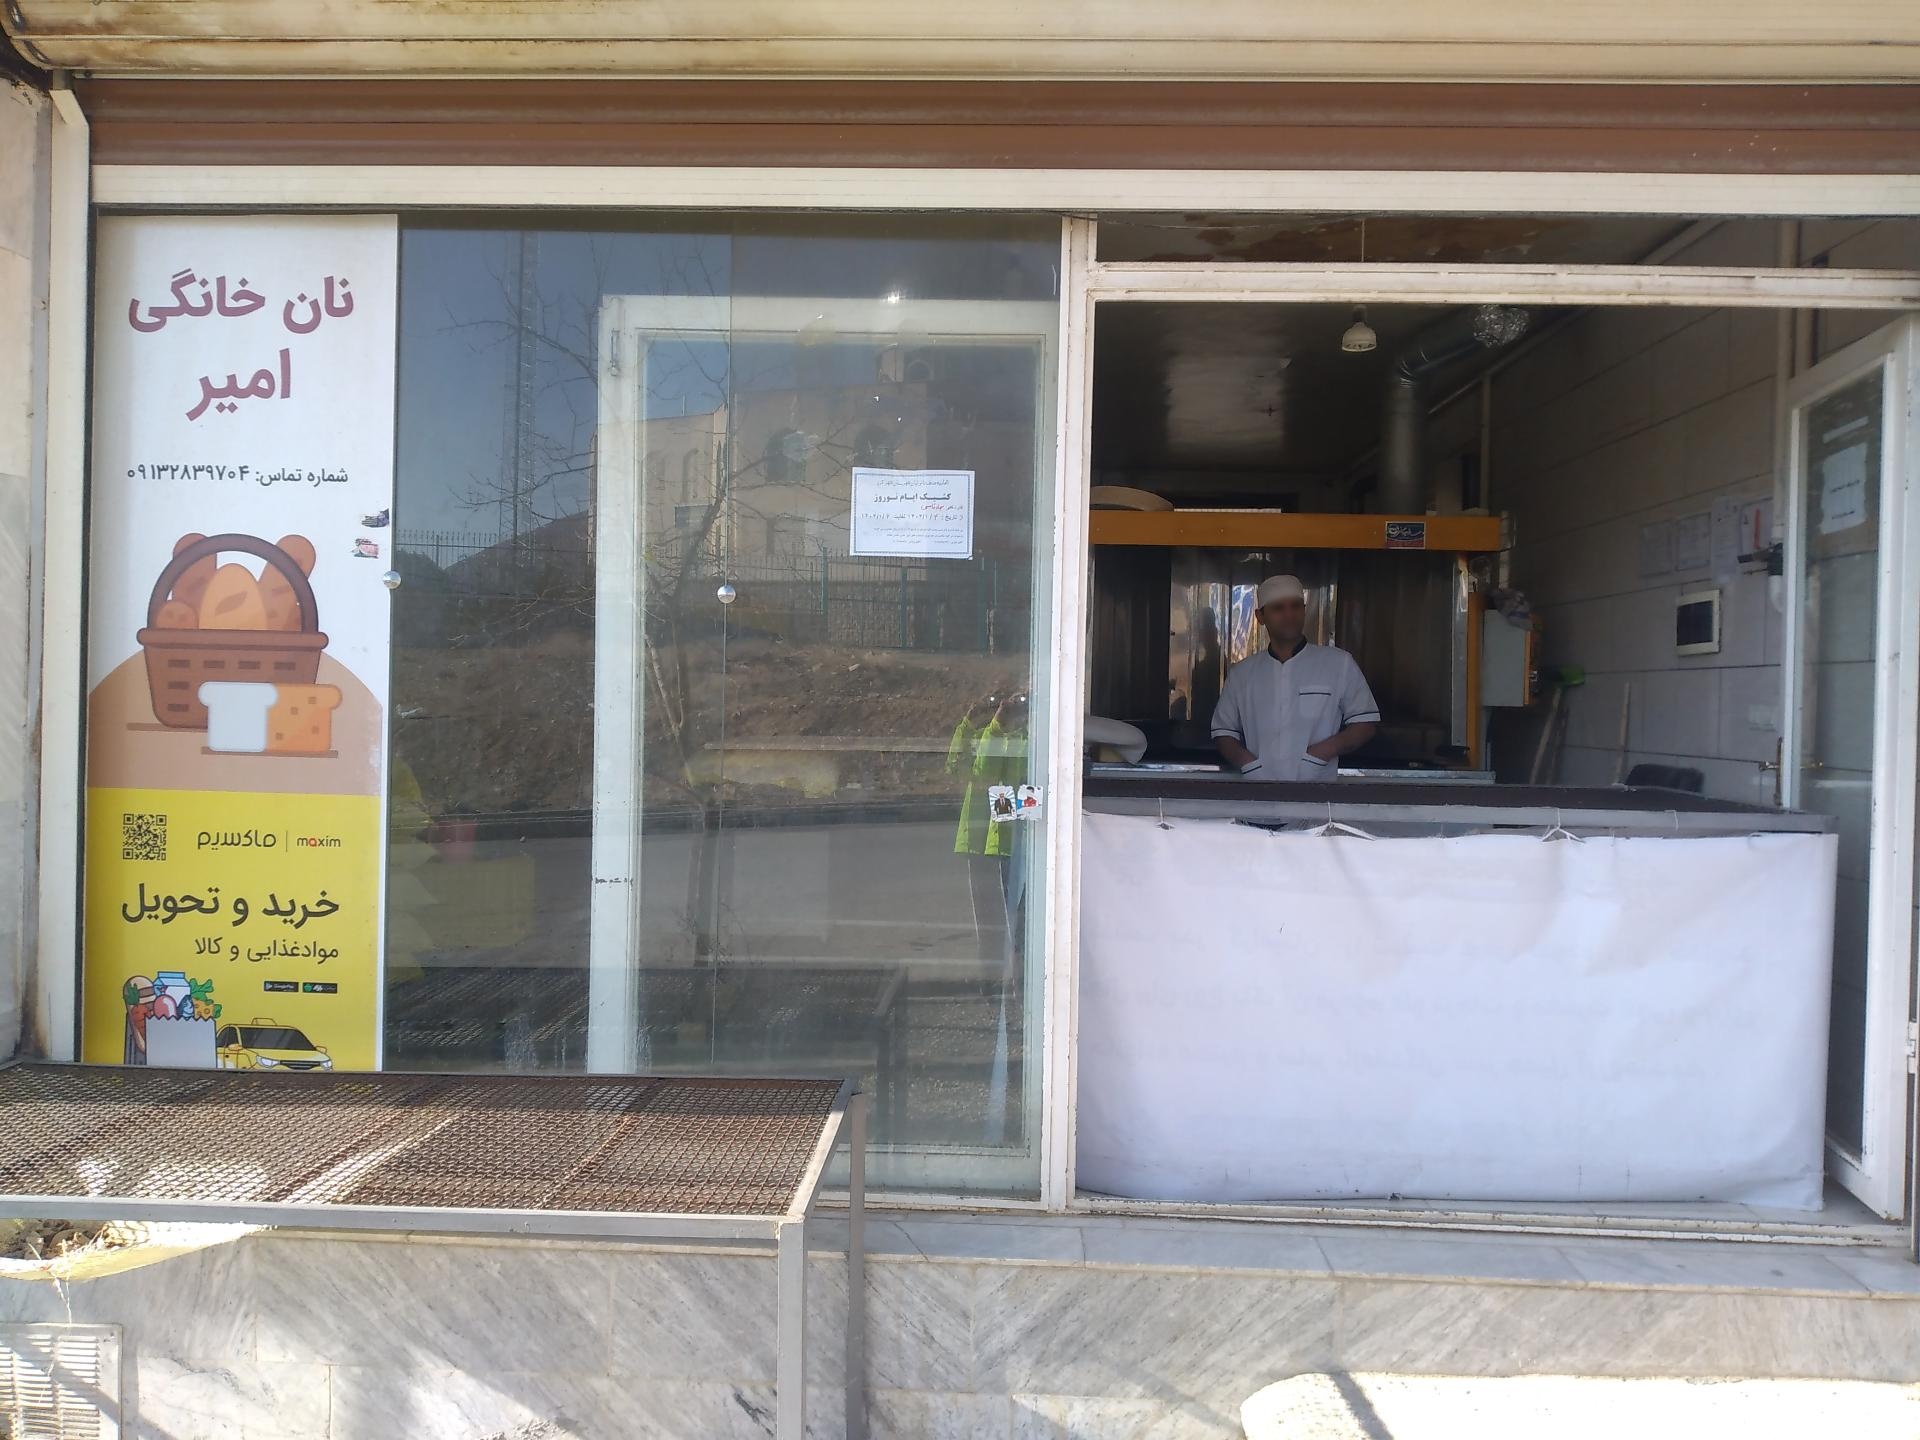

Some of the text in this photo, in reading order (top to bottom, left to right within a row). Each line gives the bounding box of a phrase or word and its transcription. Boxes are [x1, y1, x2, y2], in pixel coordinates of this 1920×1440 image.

[128, 268, 355, 335] نان خانگی
[185, 348, 292, 422] امیر
[127, 463, 349, 488] شماره تماس: ۰۹۱۳۲۸۳۹۷۰۴
[197, 829, 277, 851] ماکسیم
[296, 836, 341, 848] maxim
[121, 883, 340, 930] خرید و تحویل
[194, 937, 224, 956] کالا
[230, 945, 240, 962] و
